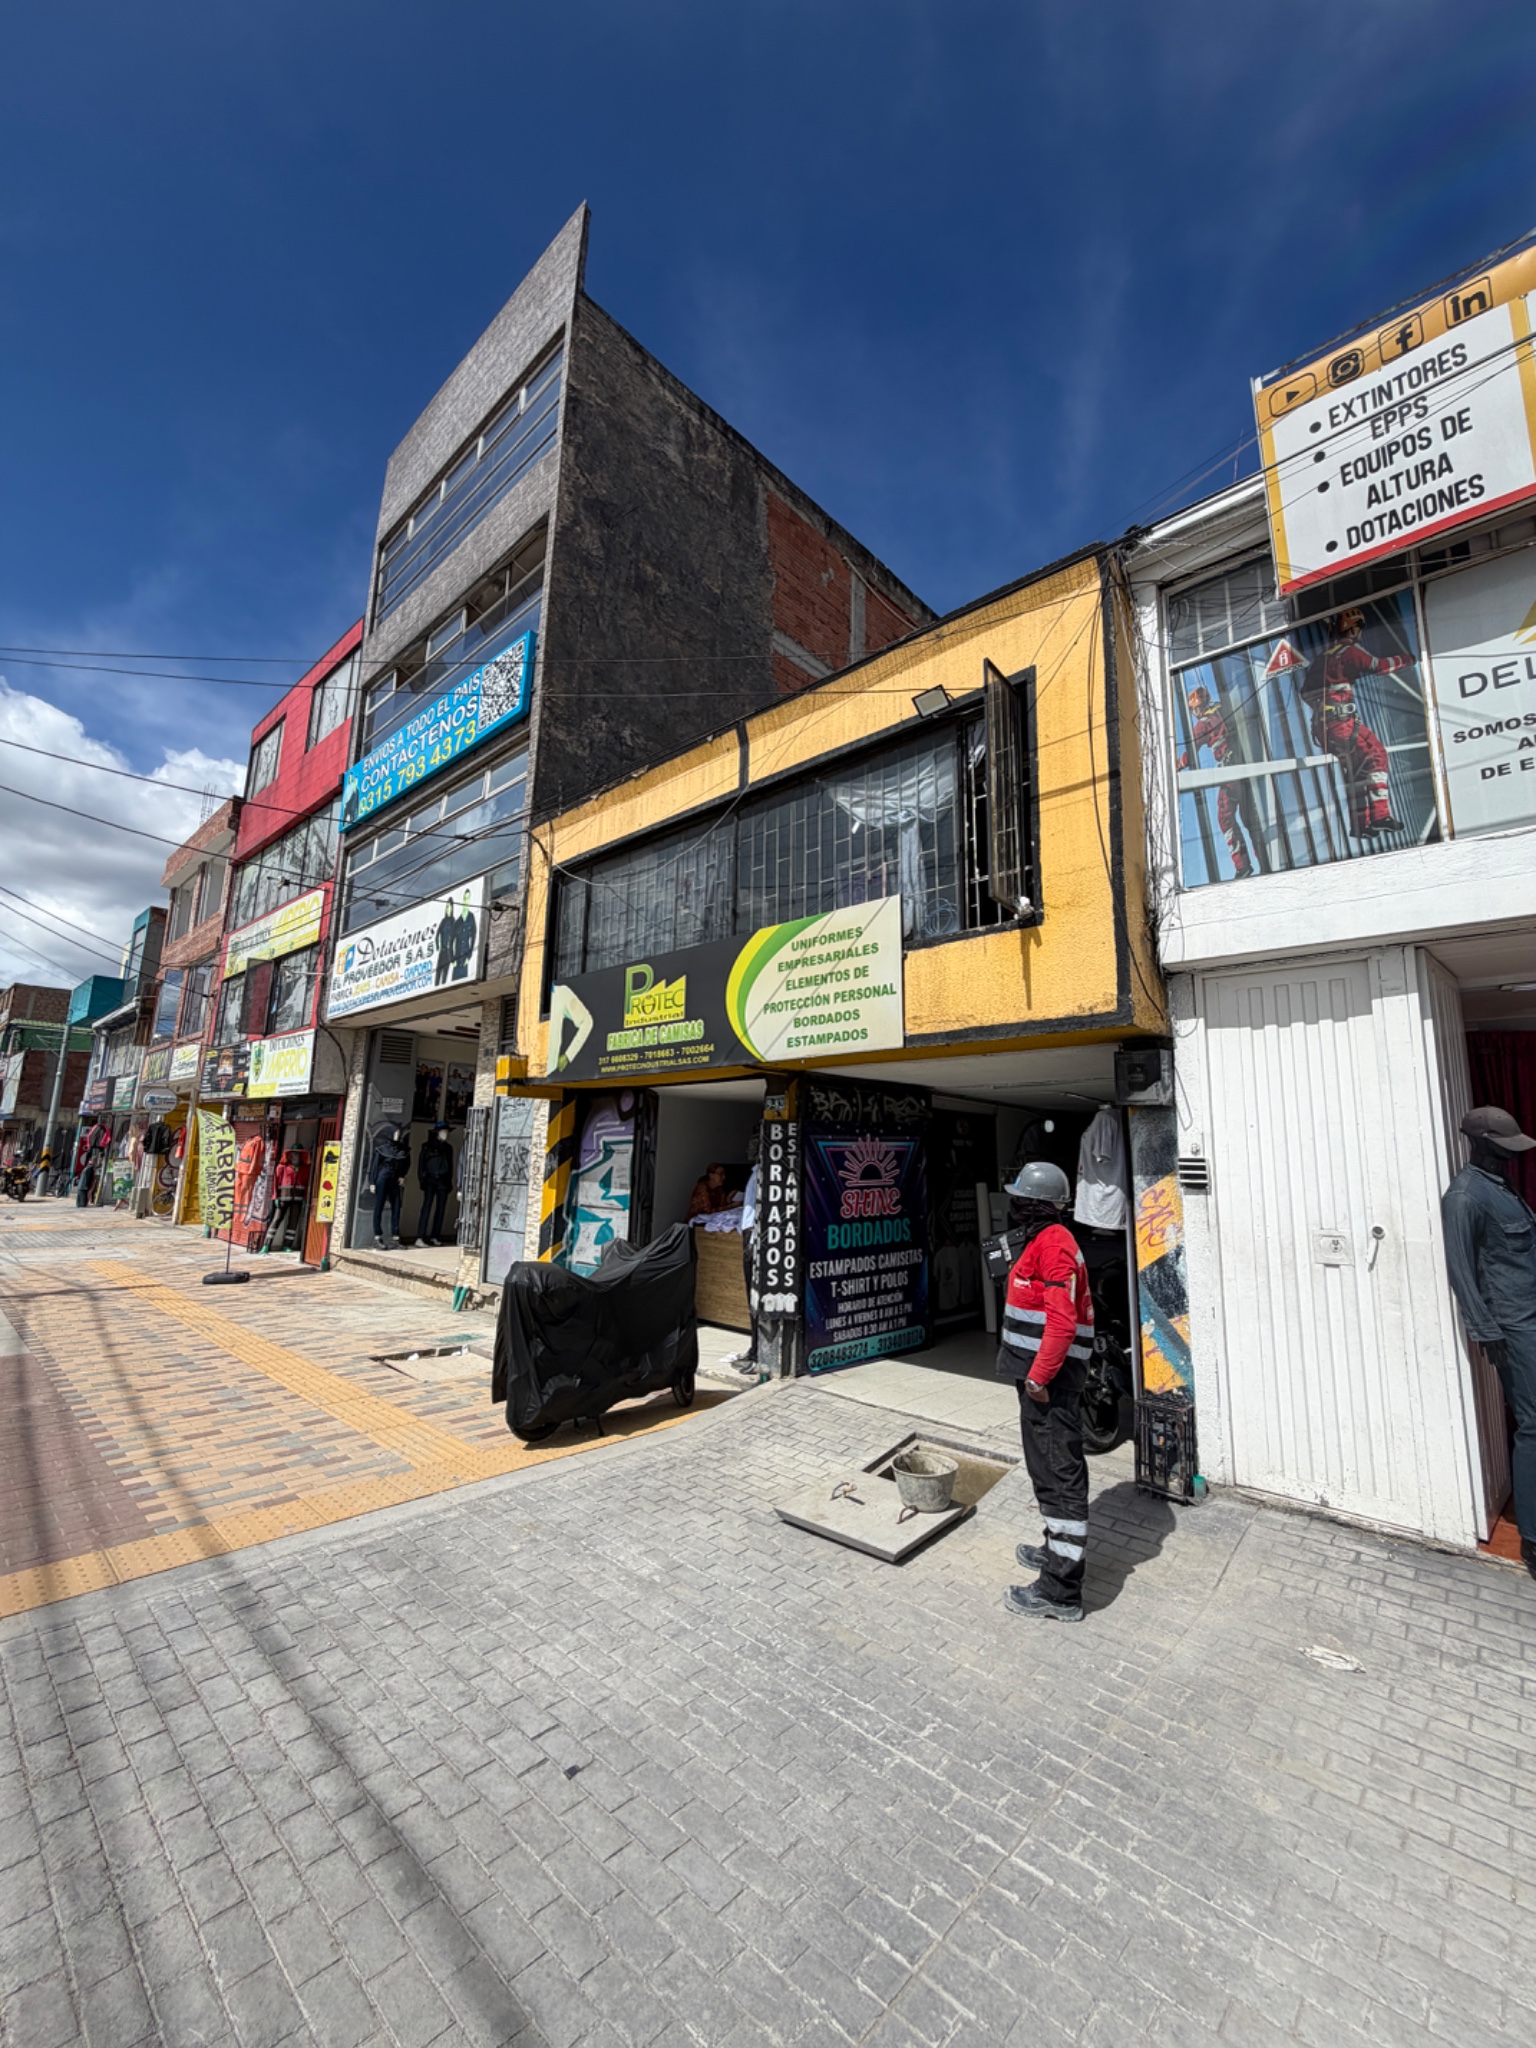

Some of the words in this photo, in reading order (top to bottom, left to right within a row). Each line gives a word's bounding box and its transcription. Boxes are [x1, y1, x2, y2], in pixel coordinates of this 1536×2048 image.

[1328, 343, 1468, 429] EXTINTORES
[1370, 395, 1429, 440] EPPS
[1340, 427, 1432, 487] EQUIPOS
[1440, 407, 1474, 442] DE
[1366, 452, 1454, 510] ALTURA
[1347, 474, 1486, 550] DOTACIONES
[397, 731, 404, 745] A
[406, 708, 435, 740] TODO
[437, 697, 450, 718] EL
[453, 672, 481, 704] PAIS
[361, 696, 478, 793] CONTACTENOS
[1453, 713, 1536, 744] SOMOS
[365, 778, 392, 811] 315
[397, 755, 426, 790] 793
[430, 720, 477, 766] 4373
[1480, 762, 1512, 780] DE
[357, 923, 437, 966] Dotaciones
[791, 926, 863, 951] UNIFORMES
[343, 953, 401, 987] PROVEEDOR
[778, 943, 880, 972] EMPRESARIALES
[785, 968, 850, 991] ELEMENTOS
[853, 965, 869, 979] DE
[834, 983, 897, 1003] PERSONAL
[625, 1010, 684, 1025] Industrial
[793, 1009, 861, 1028] BORDADOS
[607, 1028, 643, 1051] FABRICA
[644, 1025, 658, 1046] DE
[659, 1019, 704, 1044] CAMISAS
[786, 1028, 869, 1048] ESTAMPADOS
[216, 1122, 235, 1226] FABRICA
[766, 1123, 783, 1286] BORDADOS
[783, 1122, 798, 1287] ESTAMPADOS
[840, 1187, 902, 1219] SHINE
[827, 1218, 912, 1250] BORDADOS
[809, 1255, 877, 1279] ESTAMPADOS
[878, 1248, 923, 1270] CAMISETAS
[830, 1276, 871, 1298] T-SHIRT
[872, 1275, 879, 1290] Y
[881, 1270, 909, 1289] POLOS
[825, 1315, 847, 1330] LUNES
